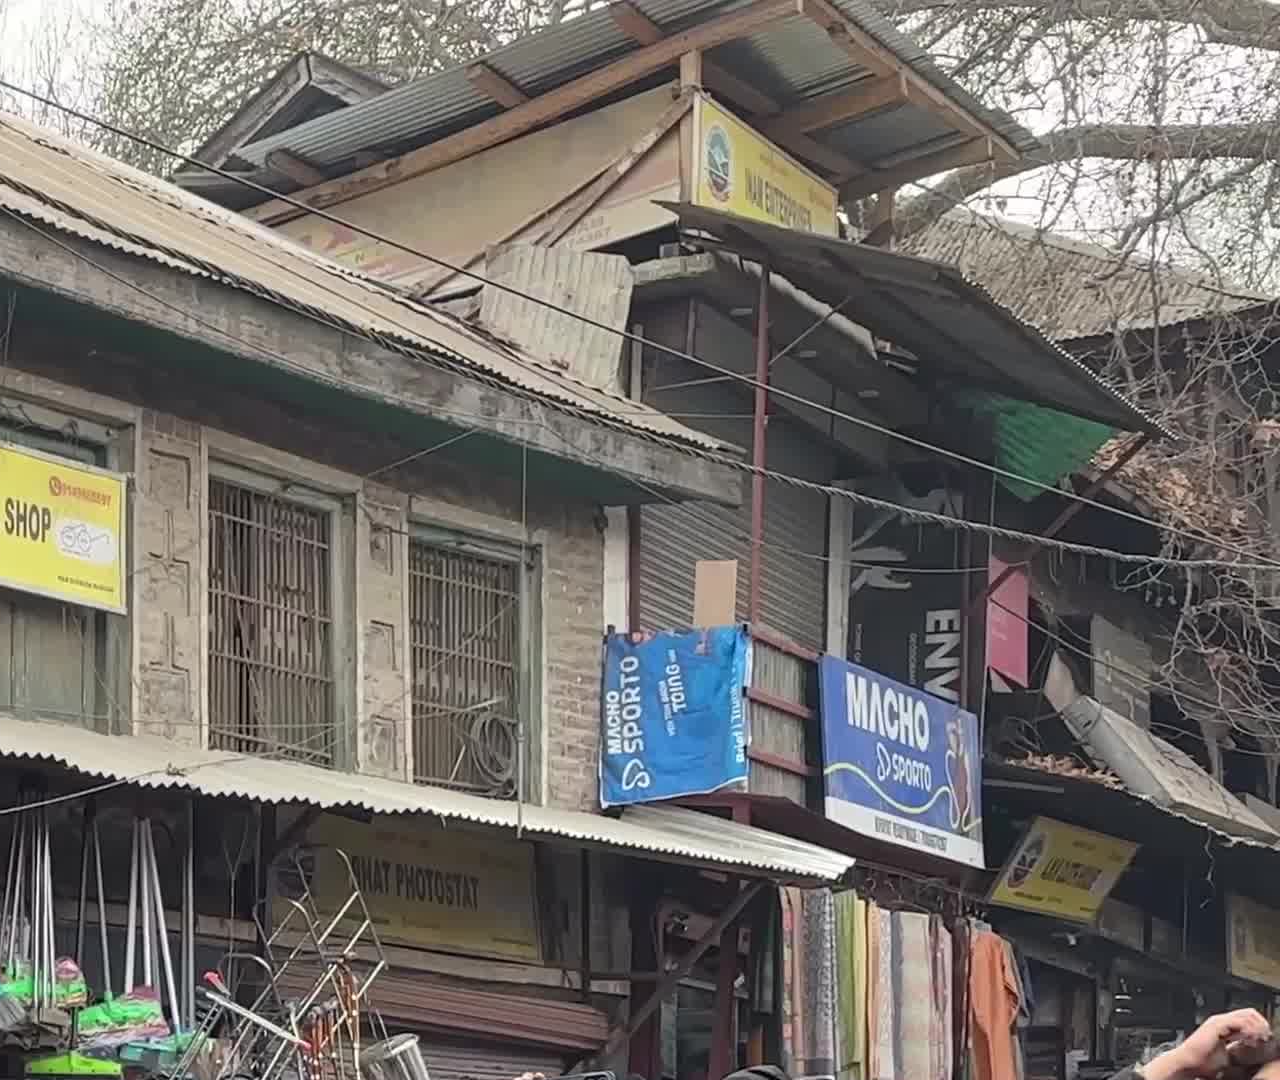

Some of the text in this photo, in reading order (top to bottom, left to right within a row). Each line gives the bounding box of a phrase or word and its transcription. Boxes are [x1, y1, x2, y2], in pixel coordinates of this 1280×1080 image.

[4, 498, 51, 543] SHOP
[606, 690, 622, 755] MACHO
[620, 655, 644, 755] SPORTO
[846, 671, 930, 752] MACHO
[891, 752, 932, 792] SPORTO
[396, 863, 479, 912] PHOTOSTAT
